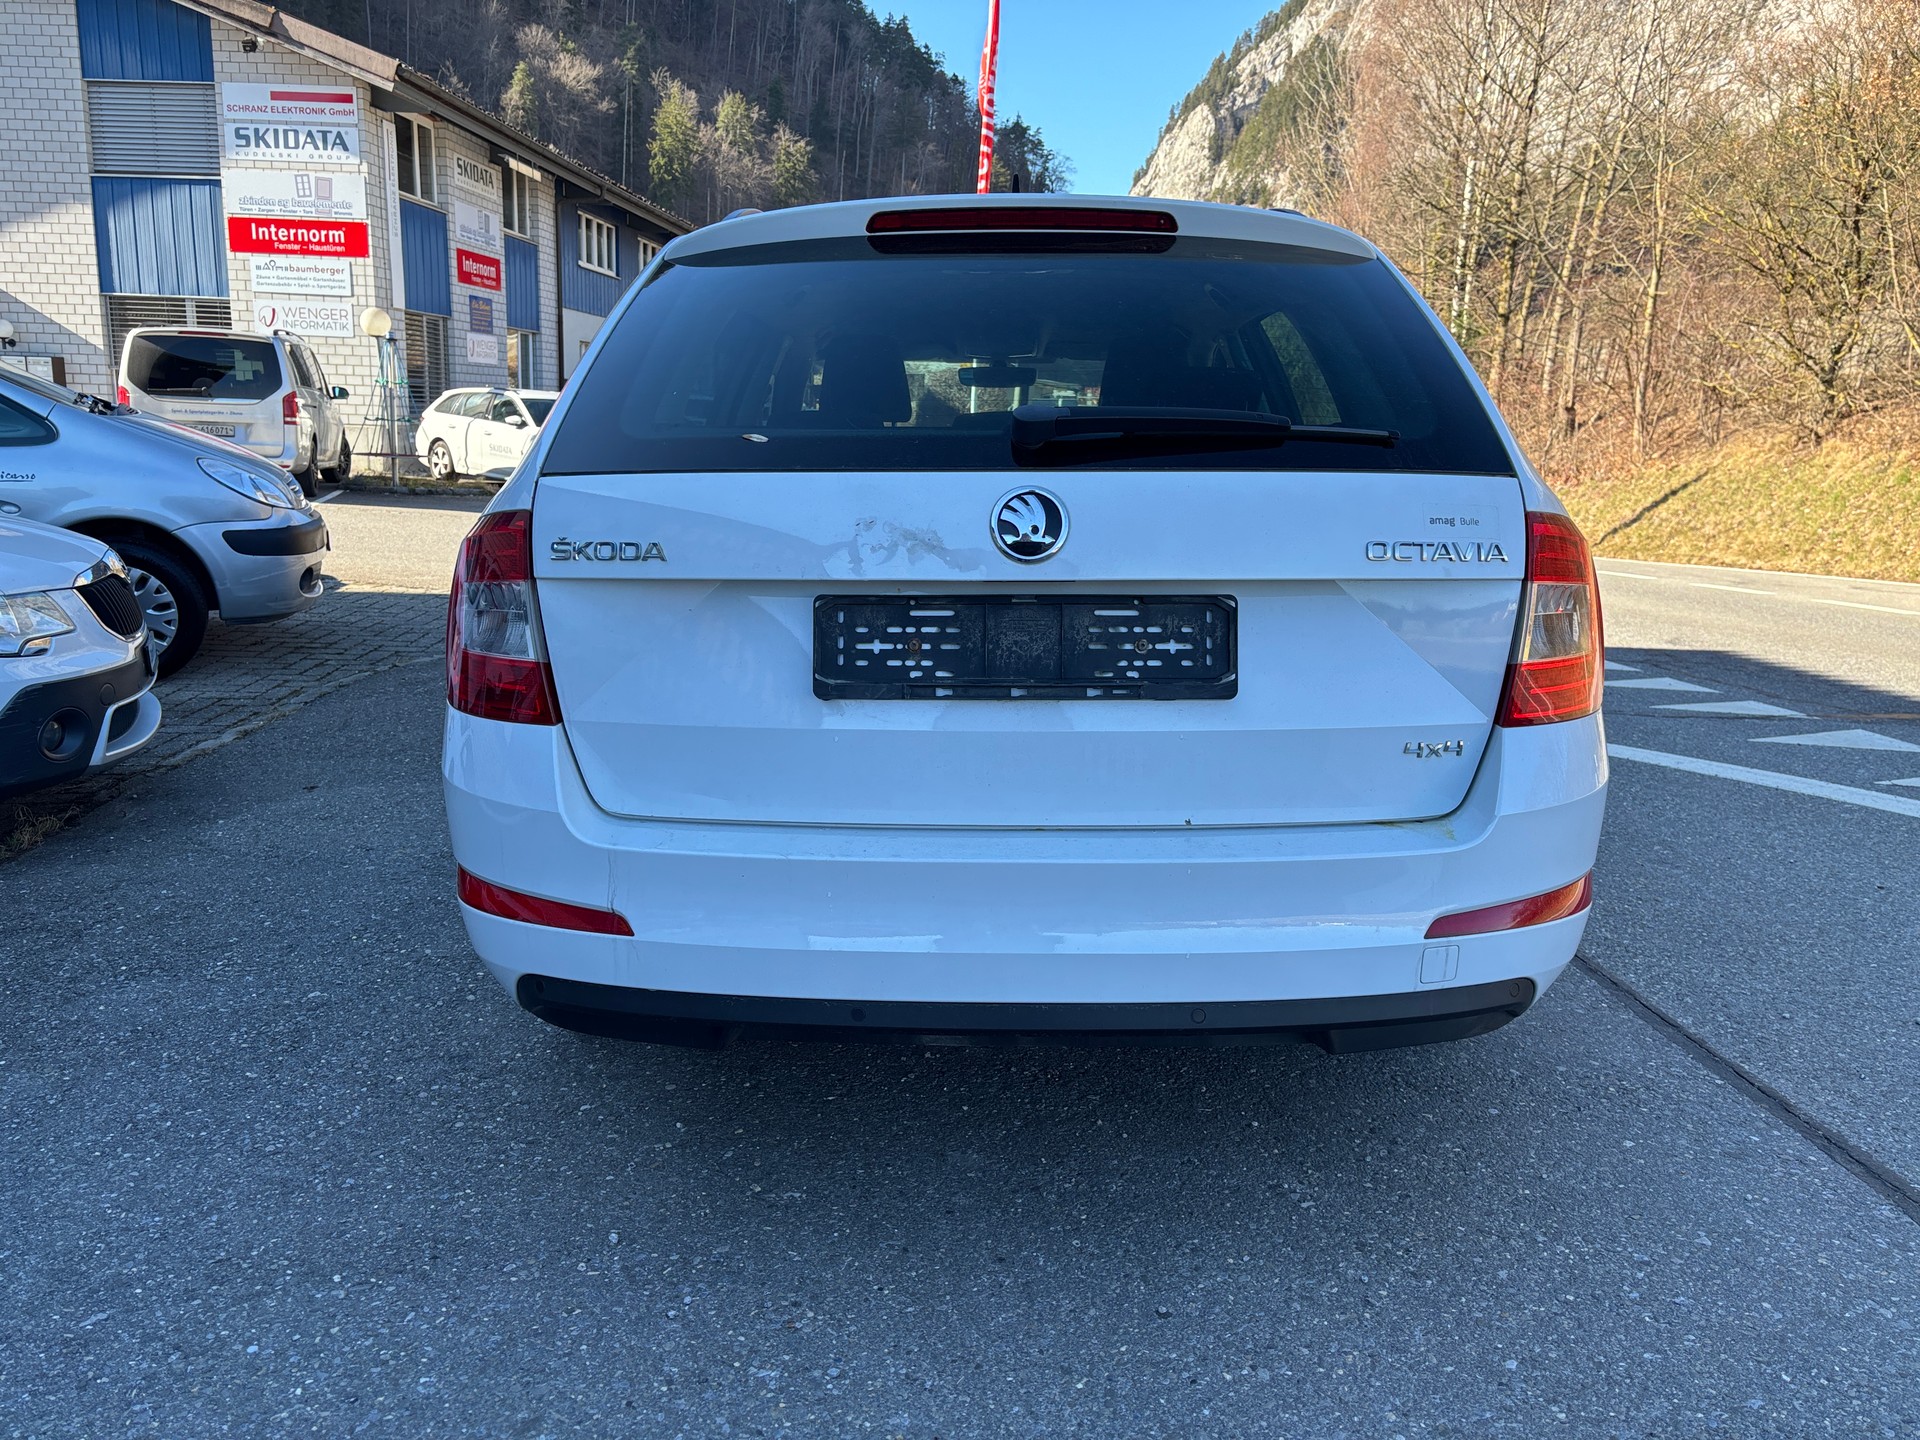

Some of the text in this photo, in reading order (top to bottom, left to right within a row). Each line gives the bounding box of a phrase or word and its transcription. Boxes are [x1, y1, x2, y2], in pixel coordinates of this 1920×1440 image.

[227, 104, 355, 117] SCHRANZ ELEKTRONIK GmbH
[234, 126, 350, 152] SKIDATA
[235, 151, 299, 159] KUDELSKI
[456, 157, 494, 189] SKIDATA
[238, 195, 353, 210] zbinden ag bauelemente
[251, 222, 345, 243] Internorm
[274, 242, 301, 251] Fenster
[308, 243, 346, 252] Haustüren
[289, 264, 345, 276] baumberger
[462, 255, 497, 279] Internorm
[282, 306, 349, 321] WENGER
[282, 319, 349, 332] INFORMATIK
[0, 471, 36, 480] icasso
[1429, 516, 1480, 527] amag Bulle
[550, 536, 668, 562] ŠKODA
[1365, 540, 1509, 562] OCTAVIA
[1403, 740, 1464, 758] 4x4
